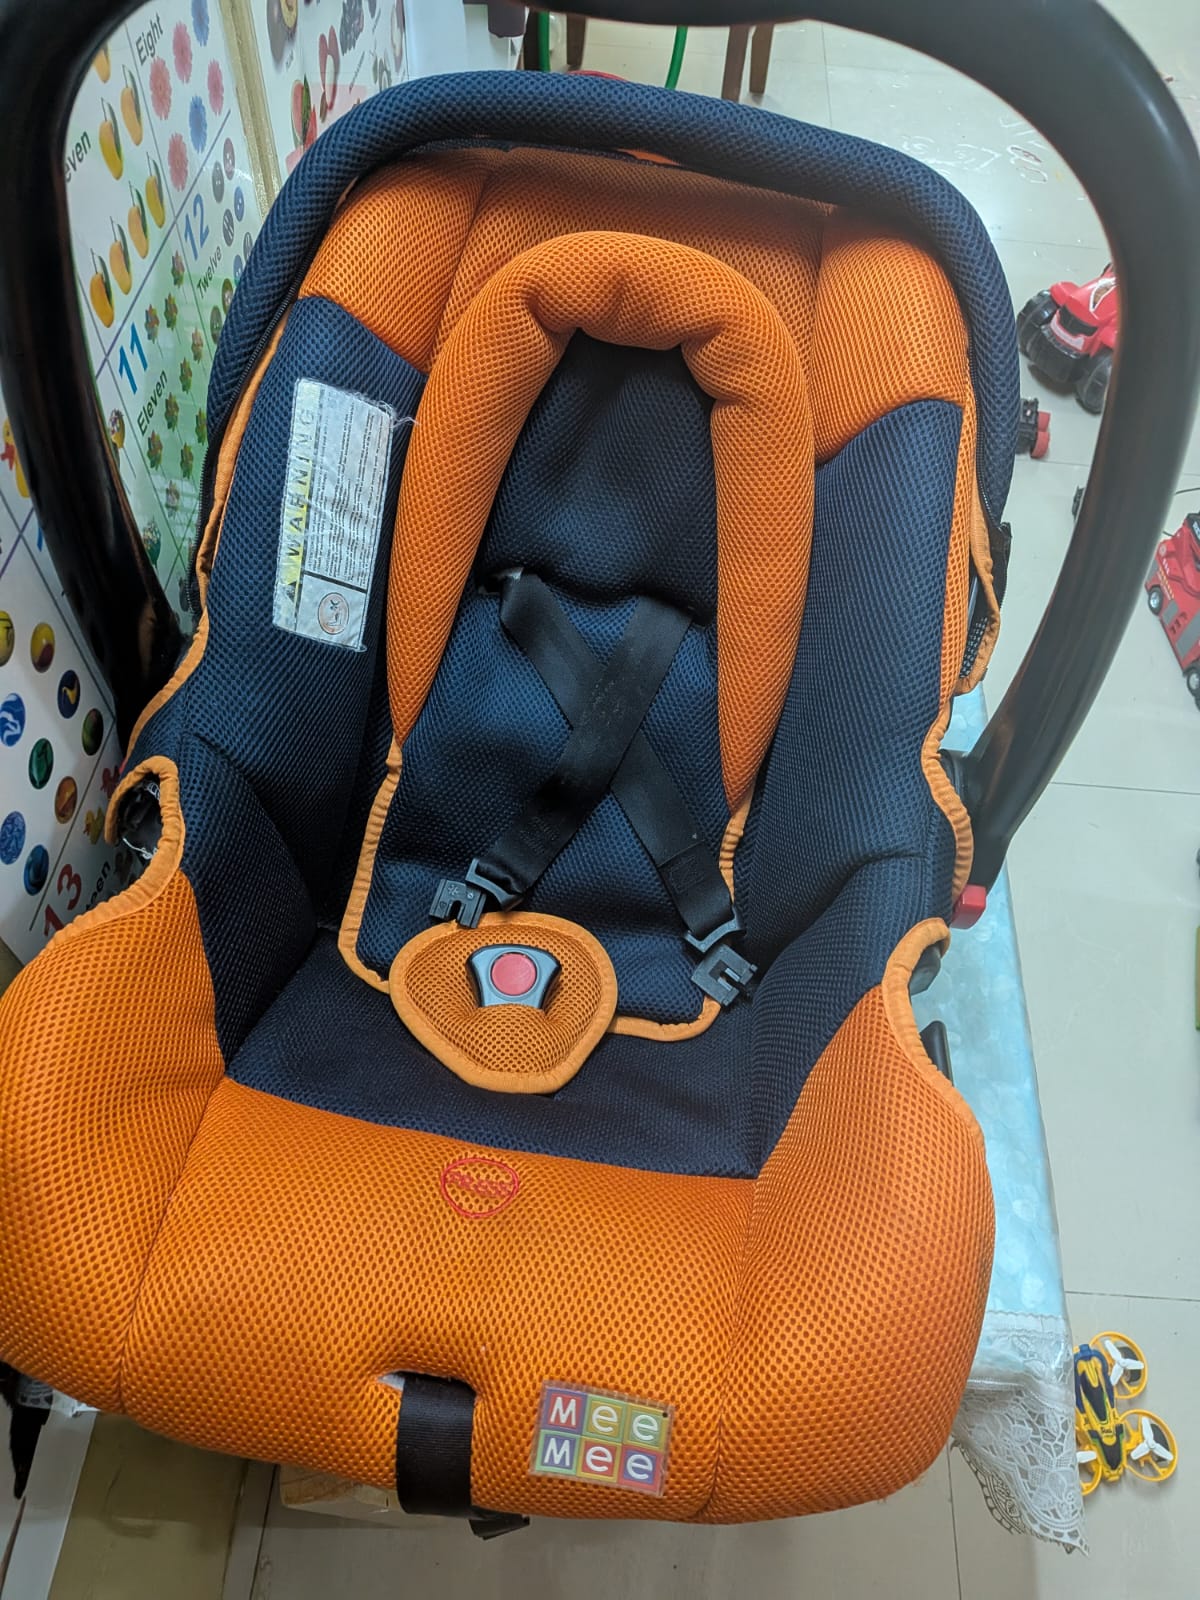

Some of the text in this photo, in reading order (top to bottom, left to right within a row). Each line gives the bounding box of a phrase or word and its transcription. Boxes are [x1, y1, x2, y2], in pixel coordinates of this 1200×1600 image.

[135, 11, 164, 67] Eight
[63, 130, 92, 184] even
[184, 193, 210, 262] 12
[196, 245, 222, 299] Twelve
[118, 322, 149, 396] 11
[136, 369, 169, 437] Eleven
[286, 407, 316, 558] WARNING
[549, 1395, 660, 1441] Mee
[543, 1436, 654, 1481] Mee
